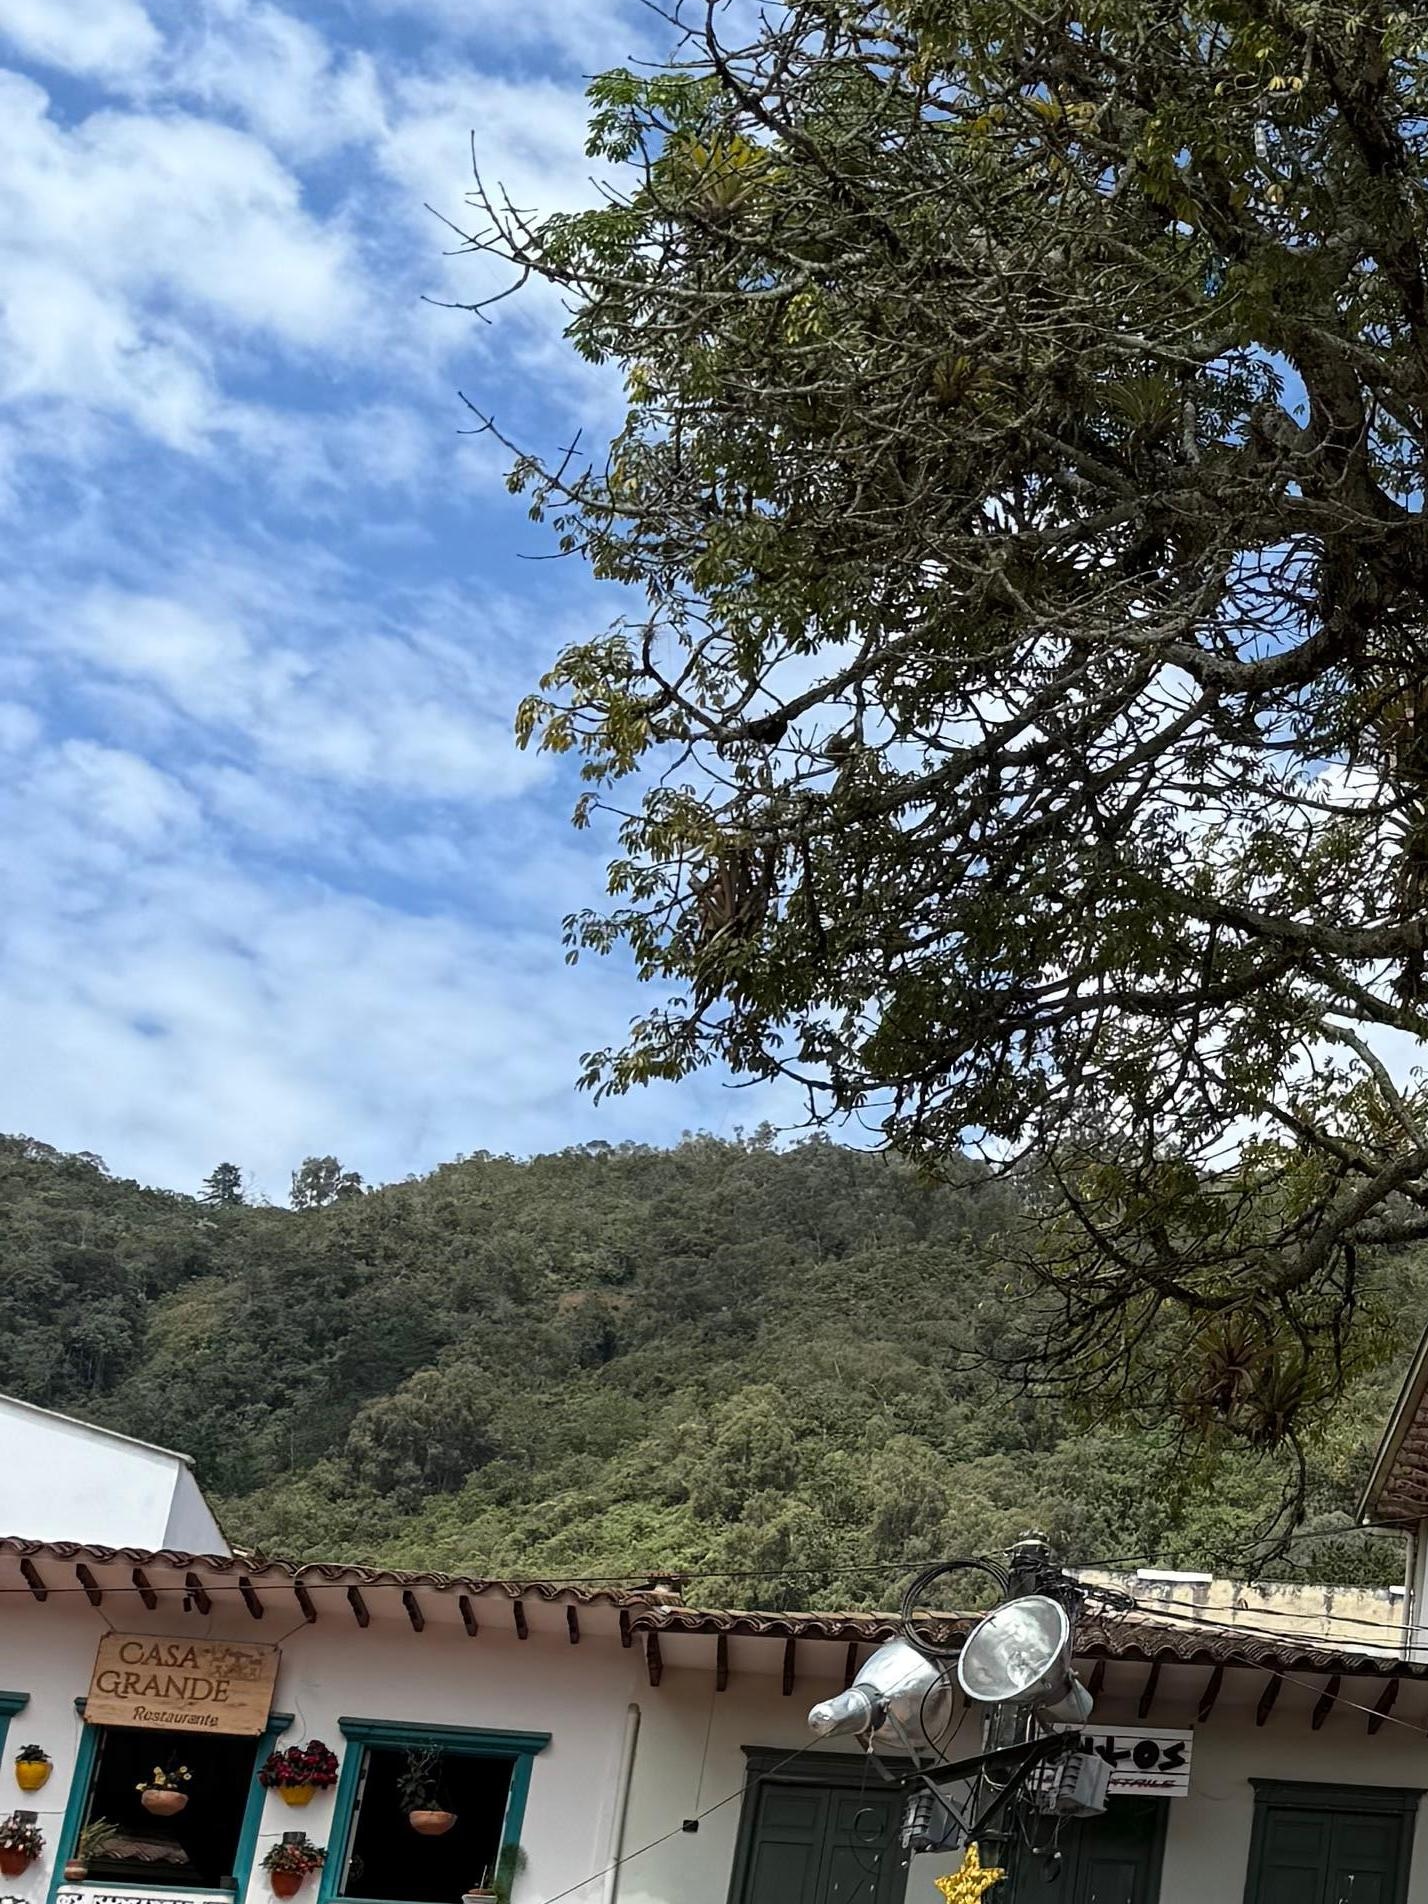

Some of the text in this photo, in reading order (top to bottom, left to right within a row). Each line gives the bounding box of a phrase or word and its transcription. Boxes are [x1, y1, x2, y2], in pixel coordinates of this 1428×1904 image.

[119, 1641, 200, 1670] CASA
[96, 1670, 231, 1703] GRANDE
[133, 1705, 219, 1727] Restaurante
